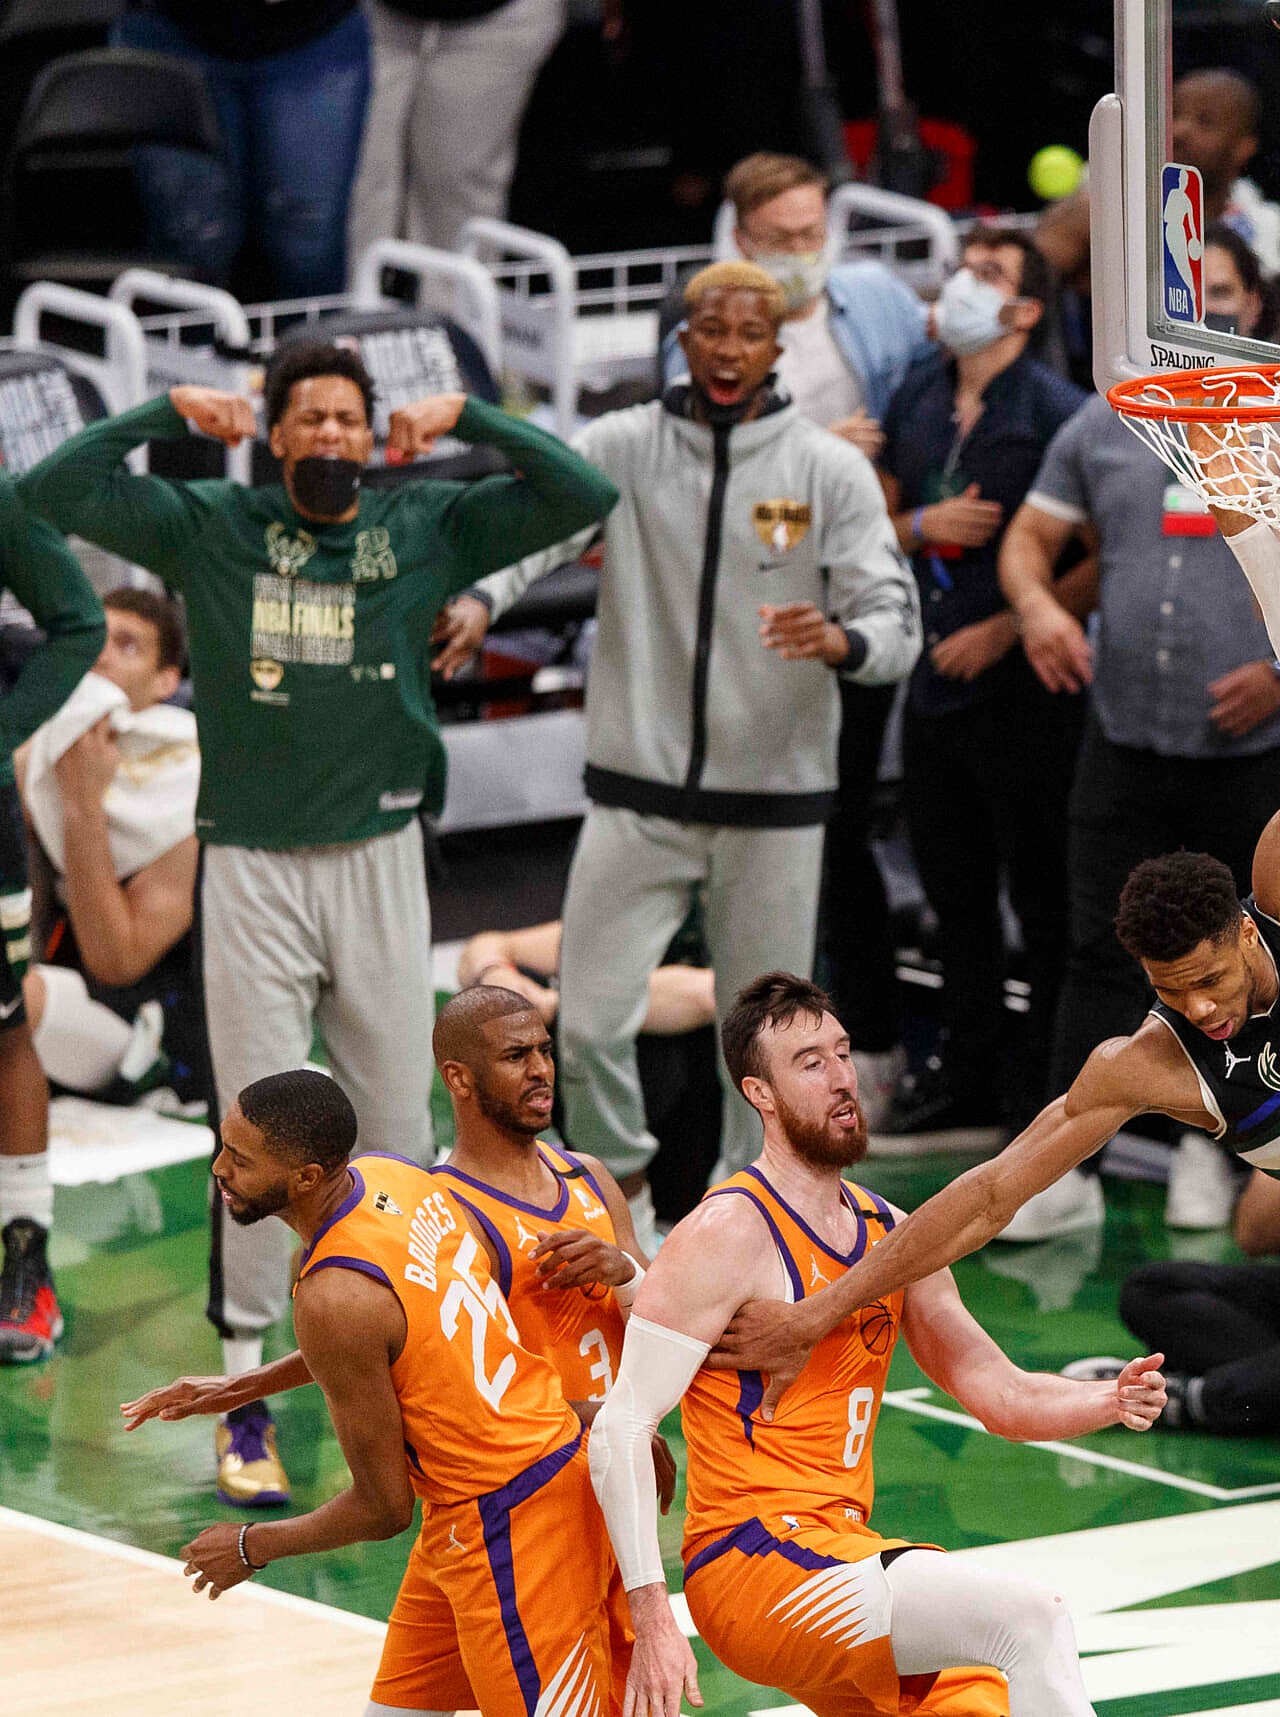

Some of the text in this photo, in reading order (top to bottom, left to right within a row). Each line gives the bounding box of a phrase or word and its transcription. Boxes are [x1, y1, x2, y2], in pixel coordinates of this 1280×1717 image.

[1168, 287, 1189, 314] NBA
[1151, 344, 1216, 369] SPALDING
[404, 1191, 457, 1292] BRIDGES
[439, 1231, 519, 1414] 25
[579, 1328, 613, 1402] 3
[843, 1387, 874, 1468] 8
